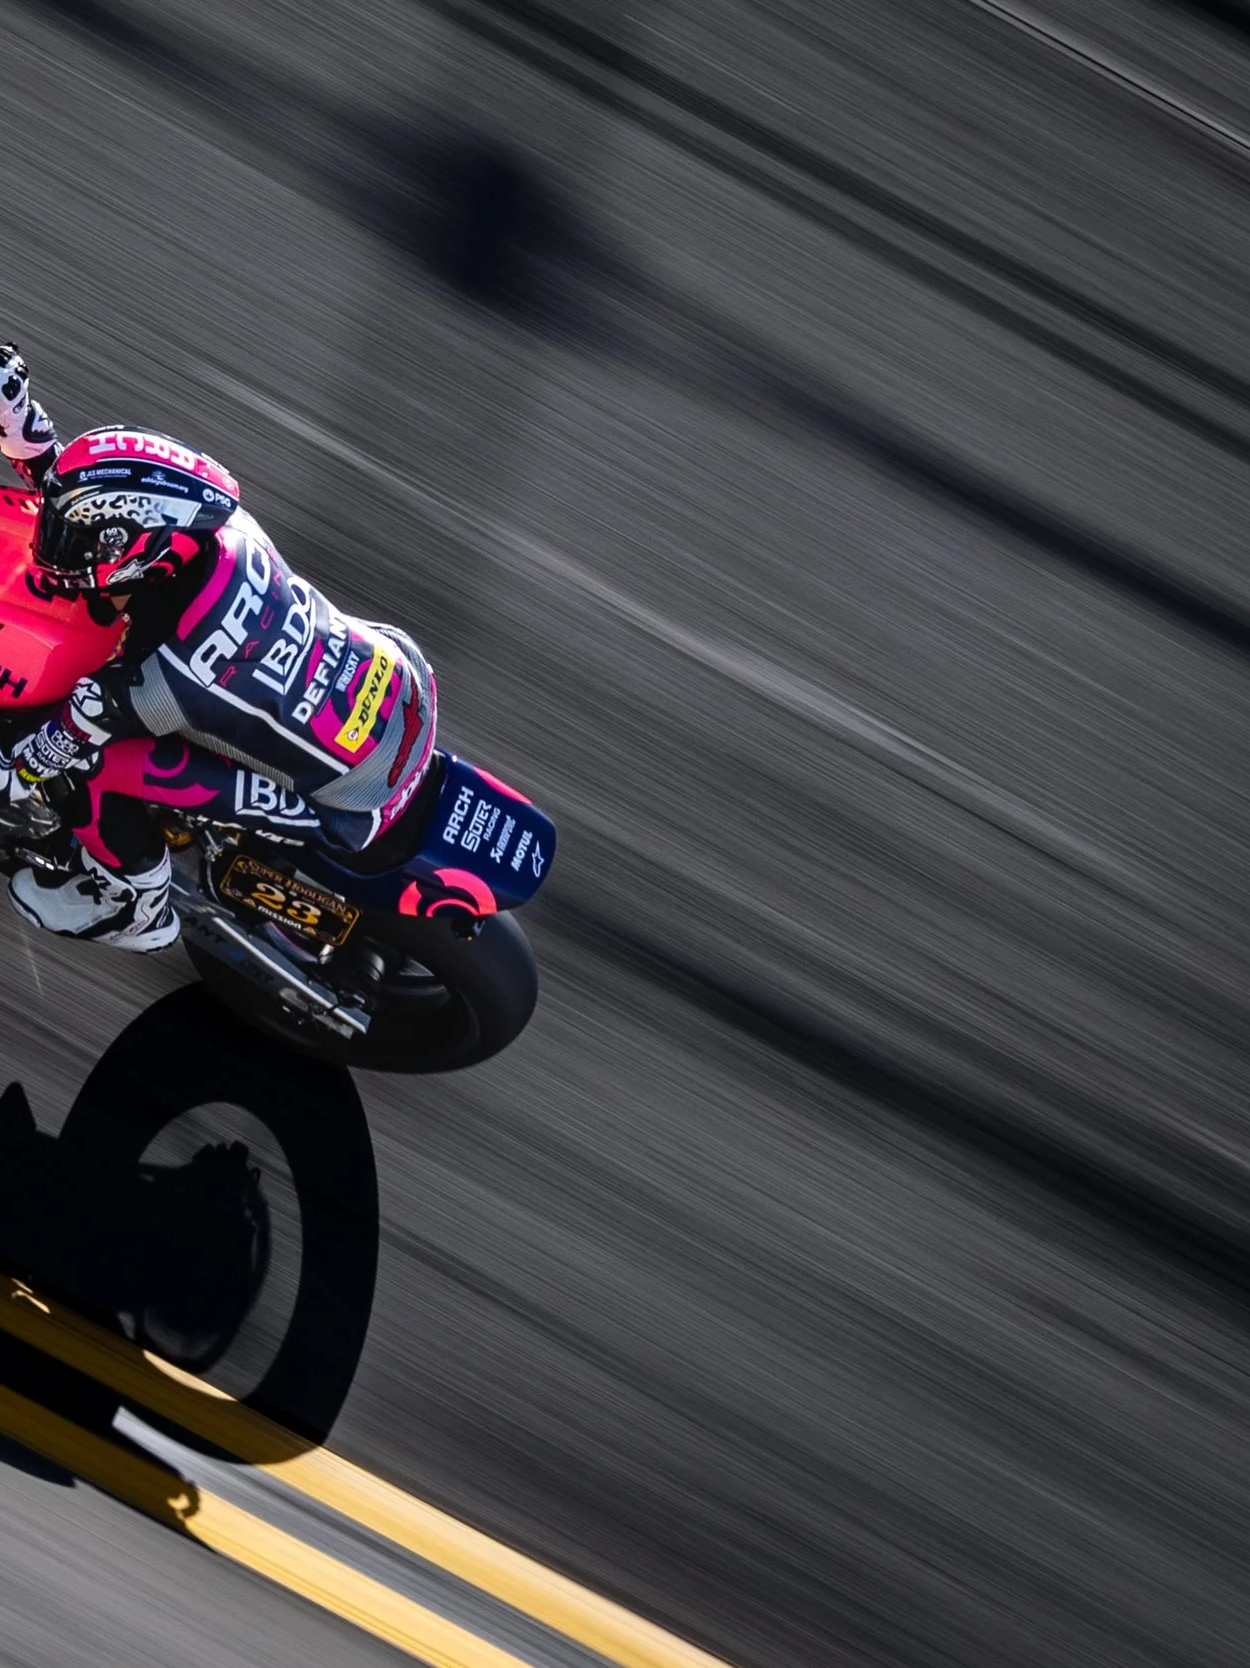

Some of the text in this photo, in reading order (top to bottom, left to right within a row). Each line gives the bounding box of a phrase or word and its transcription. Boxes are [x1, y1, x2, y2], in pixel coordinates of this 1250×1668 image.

[190, 537, 271, 688] ARC
[259, 575, 314, 680] BDO
[291, 616, 347, 725] DEFIAN
[334, 650, 361, 693] WHISKY
[358, 655, 389, 726] DUNLO
[443, 785, 474, 845] ARCH
[461, 799, 492, 853] SUTER
[483, 807, 501, 841] RACING
[511, 829, 533, 872] MOTUL
[251, 882, 322, 926] 23
